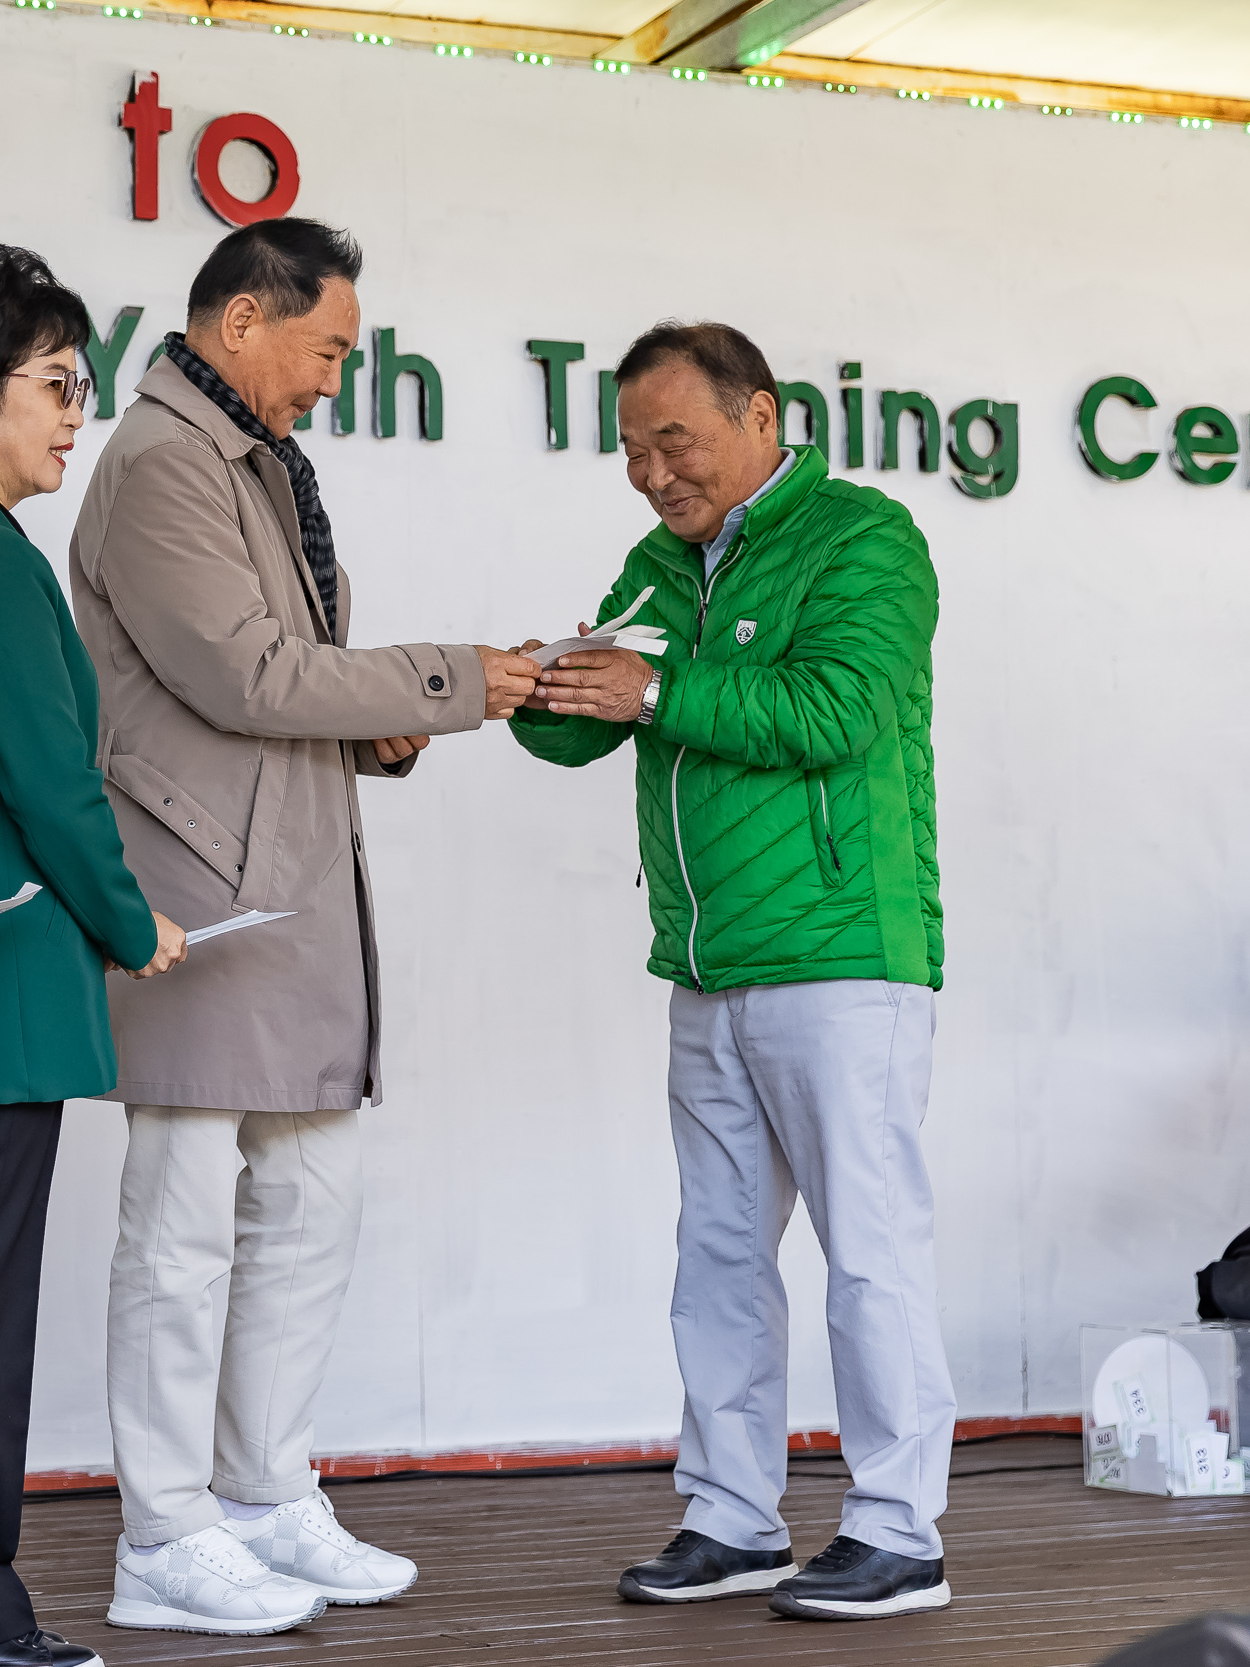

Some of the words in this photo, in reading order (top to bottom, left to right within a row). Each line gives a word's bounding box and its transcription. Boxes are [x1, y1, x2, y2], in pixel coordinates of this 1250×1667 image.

[120, 70, 301, 229] to
[81, 305, 443, 441] Yth
[526, 338, 1019, 501] Trning
[1071, 375, 1250, 486] Ce
